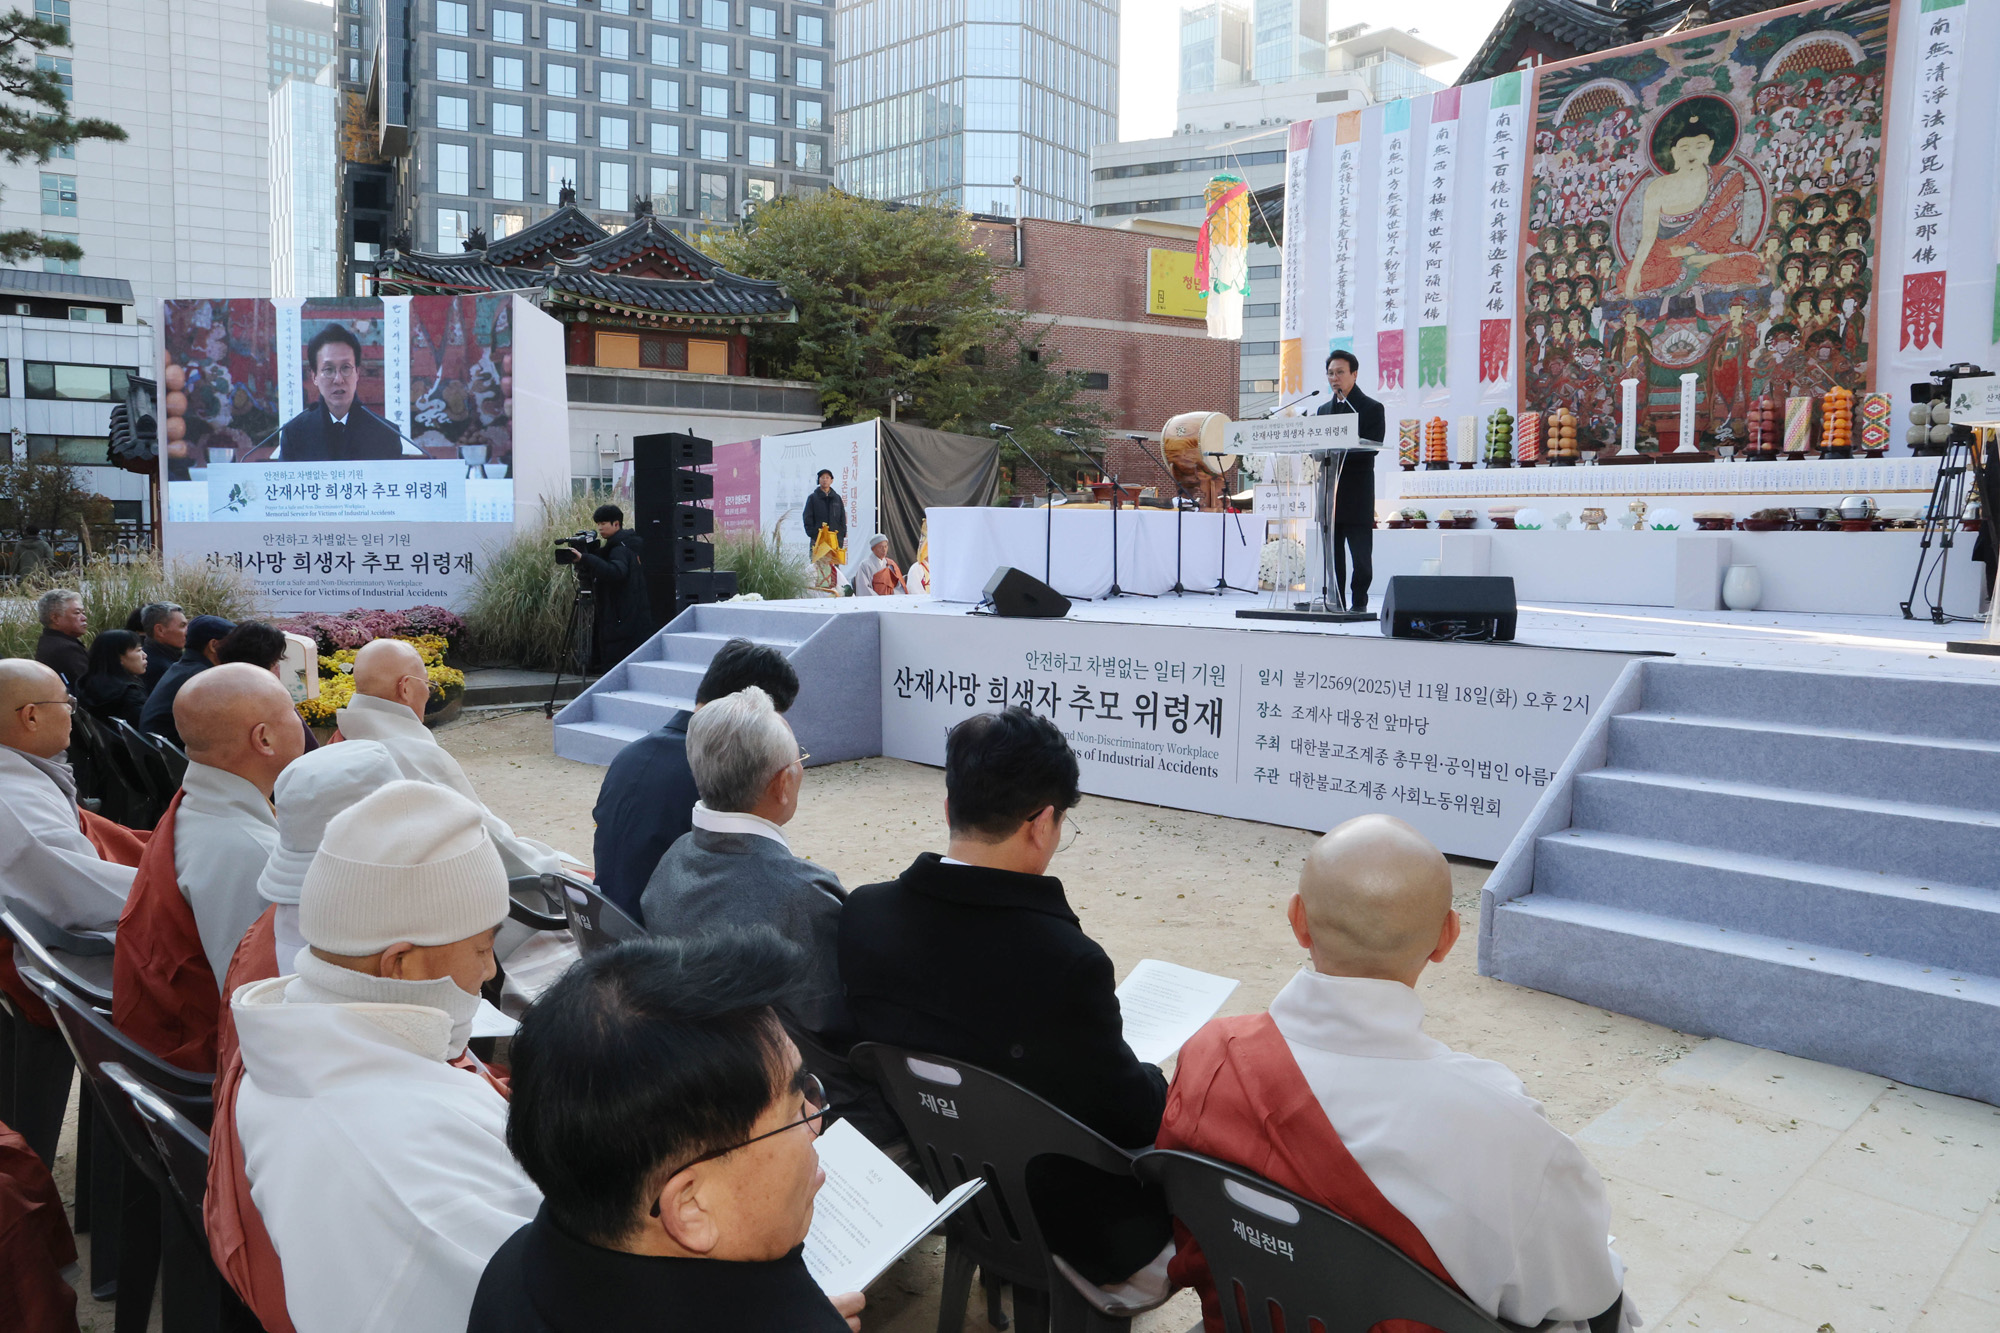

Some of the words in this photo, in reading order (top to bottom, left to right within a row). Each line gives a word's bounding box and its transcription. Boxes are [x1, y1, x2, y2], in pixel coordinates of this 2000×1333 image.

[1251, 431, 1281, 441] 산재사망
[1283, 428, 1305, 439] 희생자
[1307, 427, 1323, 437] 추모
[1325, 425, 1348, 437] 위령재
[264, 471, 296, 480] 안전하고
[297, 470, 328, 480] 차별없는
[331, 470, 346, 480] 일터
[348, 470, 364, 480] 기원
[265, 483, 321, 501] 산재사망
[325, 481, 367, 500] 희생자
[372, 482, 400, 499] 추모
[404, 481, 447, 499] 위령재
[263, 534, 309, 547] 안전하고
[312, 533, 358, 546] 차별없는
[361, 533, 384, 546] 일터
[388, 533, 411, 547] 기원
[206, 551, 287, 574] 산재사망
[293, 551, 355, 574] 희생자
[361, 552, 403, 574] 추모
[410, 552, 473, 575] 위령재
[254, 579, 274, 587] Prayer
[307, 579, 320, 587] and
[320, 579, 385, 588] Non-Discriminatory
[387, 579, 423, 588] Workplace
[272, 588, 302, 596] Service
[304, 588, 317, 596] for
[318, 588, 350, 596] Victims
[352, 588, 361, 596] of
[362, 588, 404, 597] Industrial
[405, 588, 447, 597] Accidents
[1025, 650, 1083, 673] 안전하고
[1086, 656, 1149, 680] 차별없는
[1154, 661, 1186, 684] 일터
[1192, 664, 1226, 688] 기원
[893, 666, 980, 707] 산재사망
[987, 676, 1062, 719] 희생자
[1068, 685, 1123, 722] 추모
[1132, 691, 1223, 739] 위령재
[1259, 669, 1283, 687] 일시
[1293, 671, 1412, 699] 불기2569(2025)년
[1417, 683, 1449, 702] 11월
[1454, 686, 1518, 711] 18일(화)
[1523, 692, 1558, 712] 오후
[1562, 695, 1591, 716] 2시
[1256, 702, 1282, 719] 장소
[1291, 706, 1333, 725] 조계사
[1337, 709, 1379, 731] 대웅전
[1384, 714, 1430, 736] 앞마당
[1076, 731, 1165, 754] Non-Discriminatory
[1166, 743, 1219, 760] Workplace
[1255, 735, 1280, 753] 주최
[1291, 738, 1389, 767] 대한불교조계종
[1393, 750, 1509, 783] 총무원·공익법인
[1084, 748, 1096, 761] of
[1098, 751, 1154, 769] Industrial
[1158, 758, 1218, 778] Accidents
[1254, 767, 1279, 785] 주관
[1289, 770, 1387, 801] 대한불교조계종
[1391, 785, 1501, 818] 사회노동위원회
[918, 1091, 960, 1119] 제일
[1231, 1218, 1294, 1262] 제일천막
